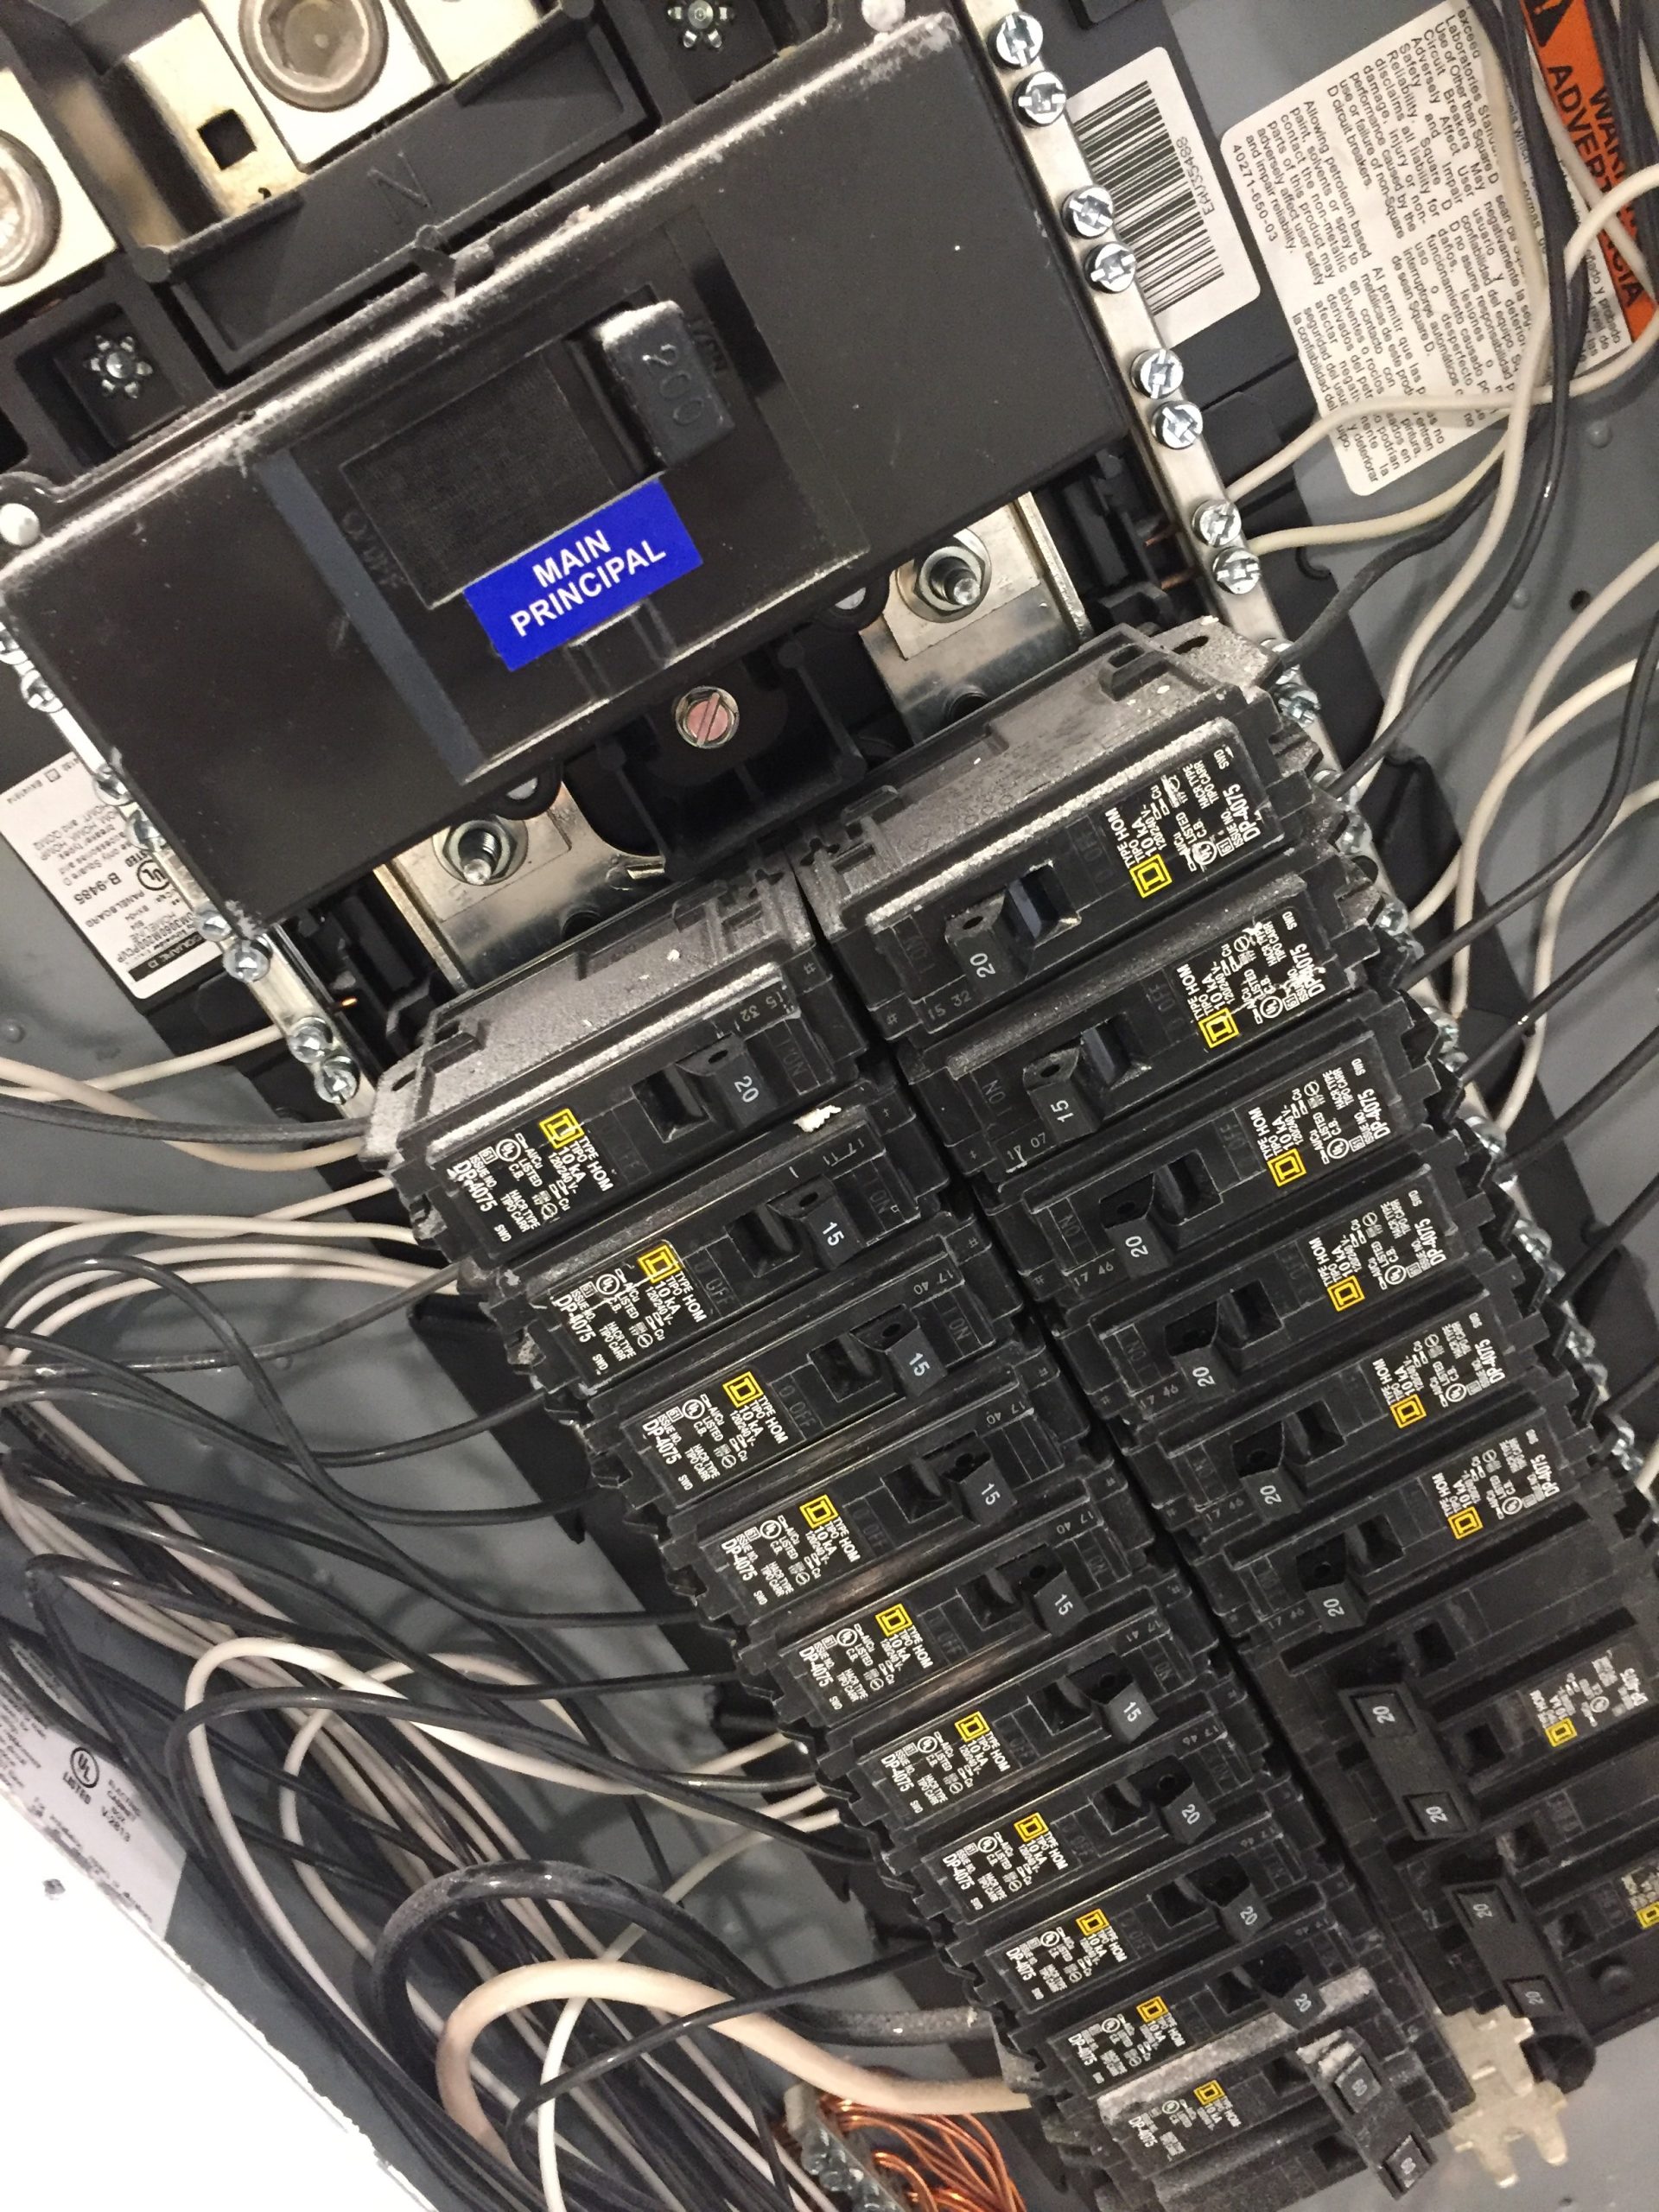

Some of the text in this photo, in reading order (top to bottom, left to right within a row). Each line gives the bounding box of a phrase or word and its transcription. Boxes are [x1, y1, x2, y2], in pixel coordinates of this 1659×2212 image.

[1445, 15, 1482, 101] Laboratories
[1327, 85, 1338, 97] D
[1424, 29, 1485, 190] Circuit Breakers May
[1434, 22, 1448, 48] Use
[1443, 48, 1456, 64] of
[1450, 65, 1467, 98] Other
[1462, 99, 1477, 128] than
[1472, 129, 1492, 171] Square
[1488, 172, 1498, 184] D
[1332, 99, 1352, 135] circuit
[1399, 42, 1463, 203] Safety and Impair
[1408, 37, 1474, 196] Adversely Affect User
[1349, 72, 1415, 232] performance caused by the
[1375, 58, 1440, 216] disclaims all liability for
[1175, 136, 1215, 216] EAV35488
[1339, 79, 1404, 238] use or failure of non-Square
[1389, 129, 1408, 167] injury
[1405, 175, 1415, 188] or
[1420, 137, 1440, 185] Square
[1441, 199, 1452, 210] D
[1233, 145, 1278, 241] 40271-650-03
[1246, 135, 1296, 253] and impair reliability.
[1281, 114, 1346, 272] contact the non-metallic
[1289, 107, 1357, 265] paint, solvents or spray to
[1303, 101, 1372, 258] Allowing petroleum based
[1257, 128, 1324, 285] adversely affect user safety
[1267, 120, 1335, 278] parts of this product may
[1461, 215, 1493, 286] confiabilidad
[1484, 201, 1520, 287] negativamente
[1376, 284, 1403, 332] permitir
[1426, 234, 1483, 377] funcionamiento causado
[1361, 308, 1382, 354] contacto
[1476, 295, 1514, 380] responsabilidad
[1441, 314, 1473, 386] desperfecto
[642, 343, 703, 425] 200
[1353, 433, 1378, 481] deteriorar
[532, 529, 611, 588] MAIN
[510, 540, 666, 637] PRINCIPAL
[1214, 749, 1229, 769] SWD
[1192, 785, 1210, 809] HACR
[1223, 784, 1261, 842] DP-4075
[1105, 807, 1135, 868] TYPE HOM
[1131, 817, 1157, 856] 10 kA
[1145, 817, 1166, 850] 120/240
[1176, 812, 1197, 844] LISTED
[1192, 818, 1207, 838] C.B.
[1128, 839, 1145, 861] TIPO
[72, 871, 122, 906] B-9485
[84, 889, 145, 928] PANELBOARD
[969, 952, 995, 978] 20
[1177, 964, 1199, 995] HOM
[1202, 973, 1225, 1010] 10 kA
[734, 1075, 759, 1103] 20
[1051, 1100, 1074, 1122] 15
[1249, 1107, 1270, 1136] HOM
[1357, 1089, 1390, 1139] DP-4075
[558, 1147, 586, 1182] 10 kA
[569, 1141, 588, 1162] TIPO
[579, 1135, 613, 1191] TYPE HOM
[518, 1158, 542, 1186] LISTED
[822, 1221, 845, 1247] 15
[1125, 1236, 1148, 1257] 20
[1309, 1237, 1330, 1264] HOM
[1414, 1218, 1446, 1266] DP-4075
[682, 1294, 707, 1322] HOM
[909, 1352, 930, 1376] 15
[1192, 1366, 1216, 1387] 20
[1372, 1358, 1392, 1384] HOM
[1474, 1339, 1505, 1383] DP-4075
[642, 1419, 682, 1464] DP-4075
[765, 1417, 788, 1443] HOM
[1432, 1472, 1451, 1497] HOM
[1530, 1454, 1560, 1497] DP-4075
[981, 1483, 1001, 1506] 15
[1260, 1484, 1282, 1505] 20
[721, 1538, 758, 1580] DP-4075
[839, 1536, 860, 1562] HOM
[1054, 1594, 1073, 1616] 15
[1323, 1598, 1344, 1618] 20
[799, 1646, 834, 1687] DP-4075
[912, 1644, 933, 1668] HOM
[1123, 1701, 1141, 1722] 15
[1372, 1706, 1395, 1724] 20
[881, 1753, 914, 1791] DP-4075
[990, 1749, 1010, 1771] HOM
[1181, 1803, 1200, 1824] 20
[1426, 1806, 1449, 1823] 20
[943, 1853, 975, 1890] DP-4075
[1049, 1848, 1068, 1870] HOM
[1239, 1905, 1258, 1926] 20
[1473, 1904, 1493, 1918] 20
[1295, 1993, 1312, 2012] 20
[1525, 1991, 1544, 2005] 20
